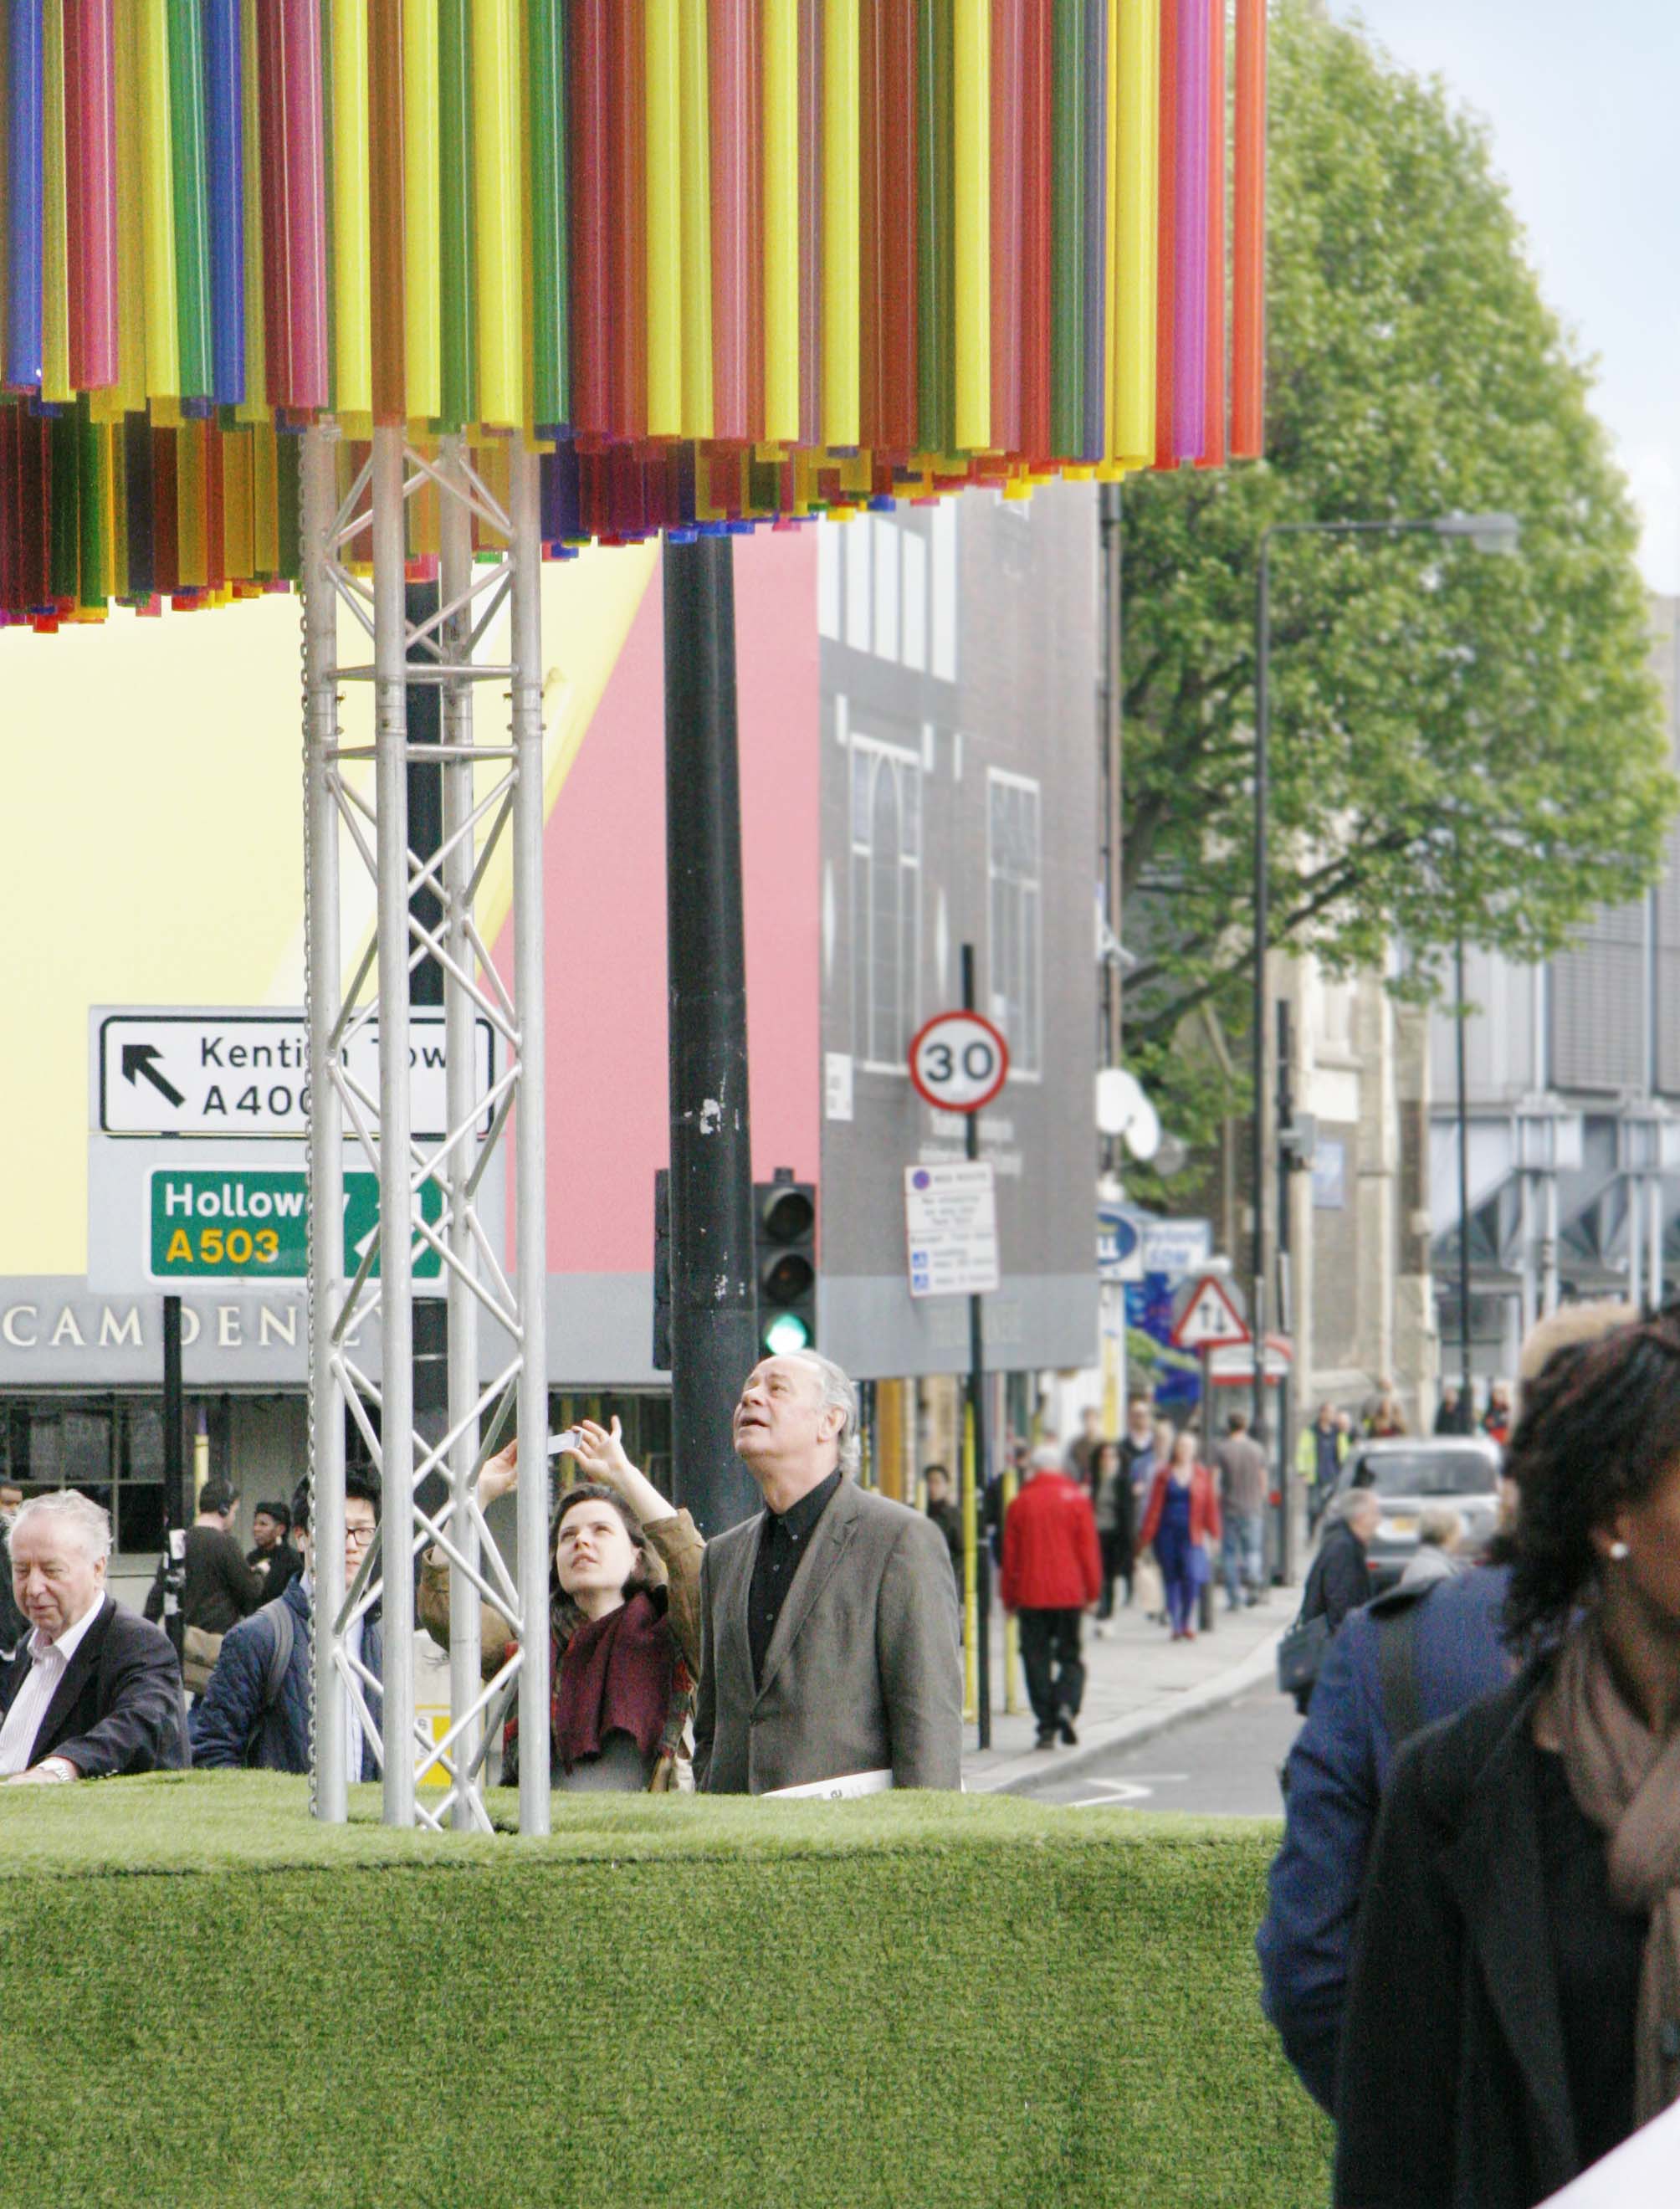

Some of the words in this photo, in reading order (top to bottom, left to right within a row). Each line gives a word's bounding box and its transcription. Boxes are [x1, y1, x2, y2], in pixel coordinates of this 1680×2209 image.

[201, 1037, 348, 1069] Kenti
[925, 1041, 994, 1082] 30
[165, 1182, 350, 1218] Hollow
[166, 1228, 279, 1264] A503
[3, 1305, 296, 1346] CAMDEN
